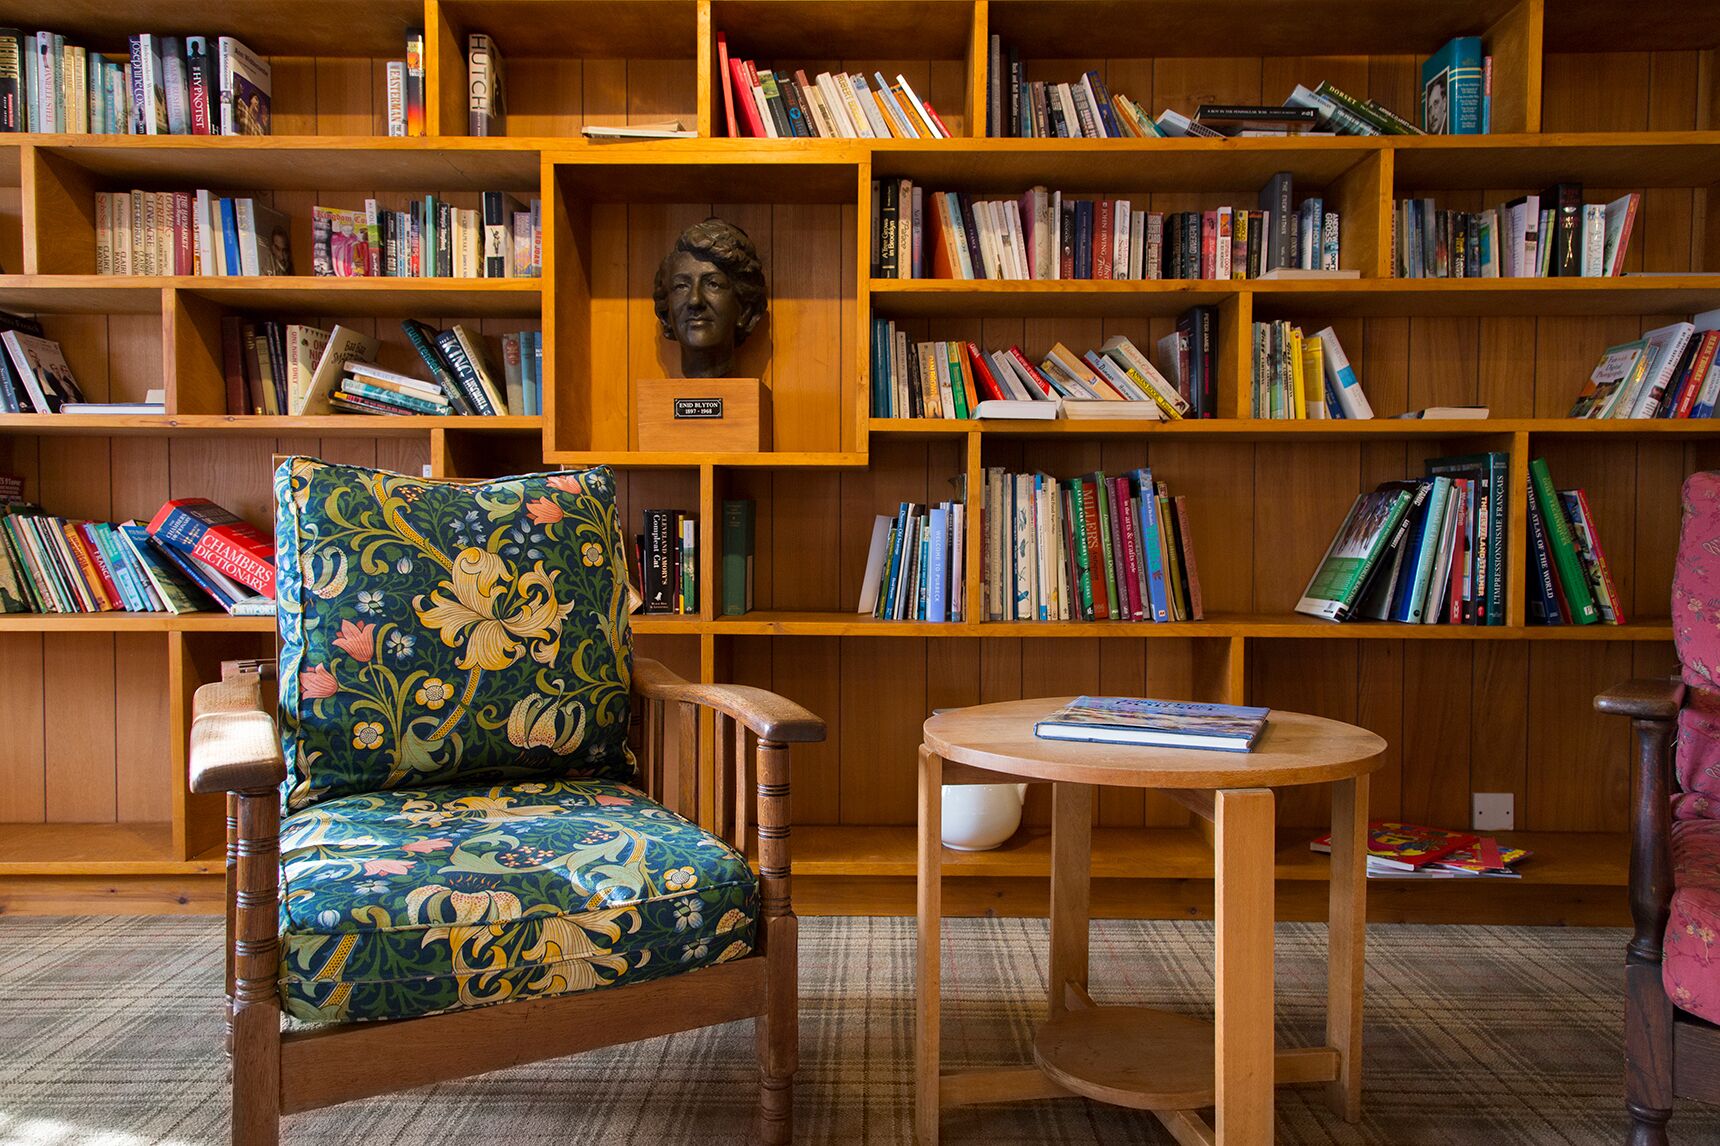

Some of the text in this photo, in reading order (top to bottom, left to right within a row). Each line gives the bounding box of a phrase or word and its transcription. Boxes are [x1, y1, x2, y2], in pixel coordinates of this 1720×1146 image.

[130, 39, 144, 106] Josephine Cox
[471, 36, 487, 110] HUTCH
[193, 72, 204, 128] HYPNOTIST
[390, 70, 402, 122] EASTERMAN
[1329, 86, 1356, 105] DORSET
[146, 200, 154, 224] LONG
[166, 194, 174, 233] GOWER
[386, 240, 396, 256] STONE
[888, 220, 896, 250] Brooklyn
[1189, 225, 1197, 254] McDERMID
[1594, 223, 1603, 252] CATHY
[419, 346, 440, 375] rendell
[442, 338, 472, 378] KING
[1098, 364, 1116, 381] Dinner
[1414, 482, 1434, 507] TITANIC
[166, 513, 186, 539] CHAMBERS
[1433, 502, 1443, 521] World
[172, 517, 191, 541] DICTIONARY
[652, 514, 660, 552] Compleat
[1494, 475, 1504, 605] L'IMPRESSIONNISME FRANÇAIS
[1527, 486, 1536, 511] TIMES
[1532, 513, 1541, 538] ATLAS
[1537, 540, 1544, 550] OF
[1543, 570, 1553, 598] WORLD
[202, 535, 273, 582] CHAMBERS
[1146, 525, 1160, 570] Walks
[94, 551, 110, 580] FRANCE
[195, 545, 267, 590] DICTIONARY
[935, 563, 941, 572] TO
[1359, 561, 1373, 580] HORSE
[1346, 580, 1362, 603] RACING
